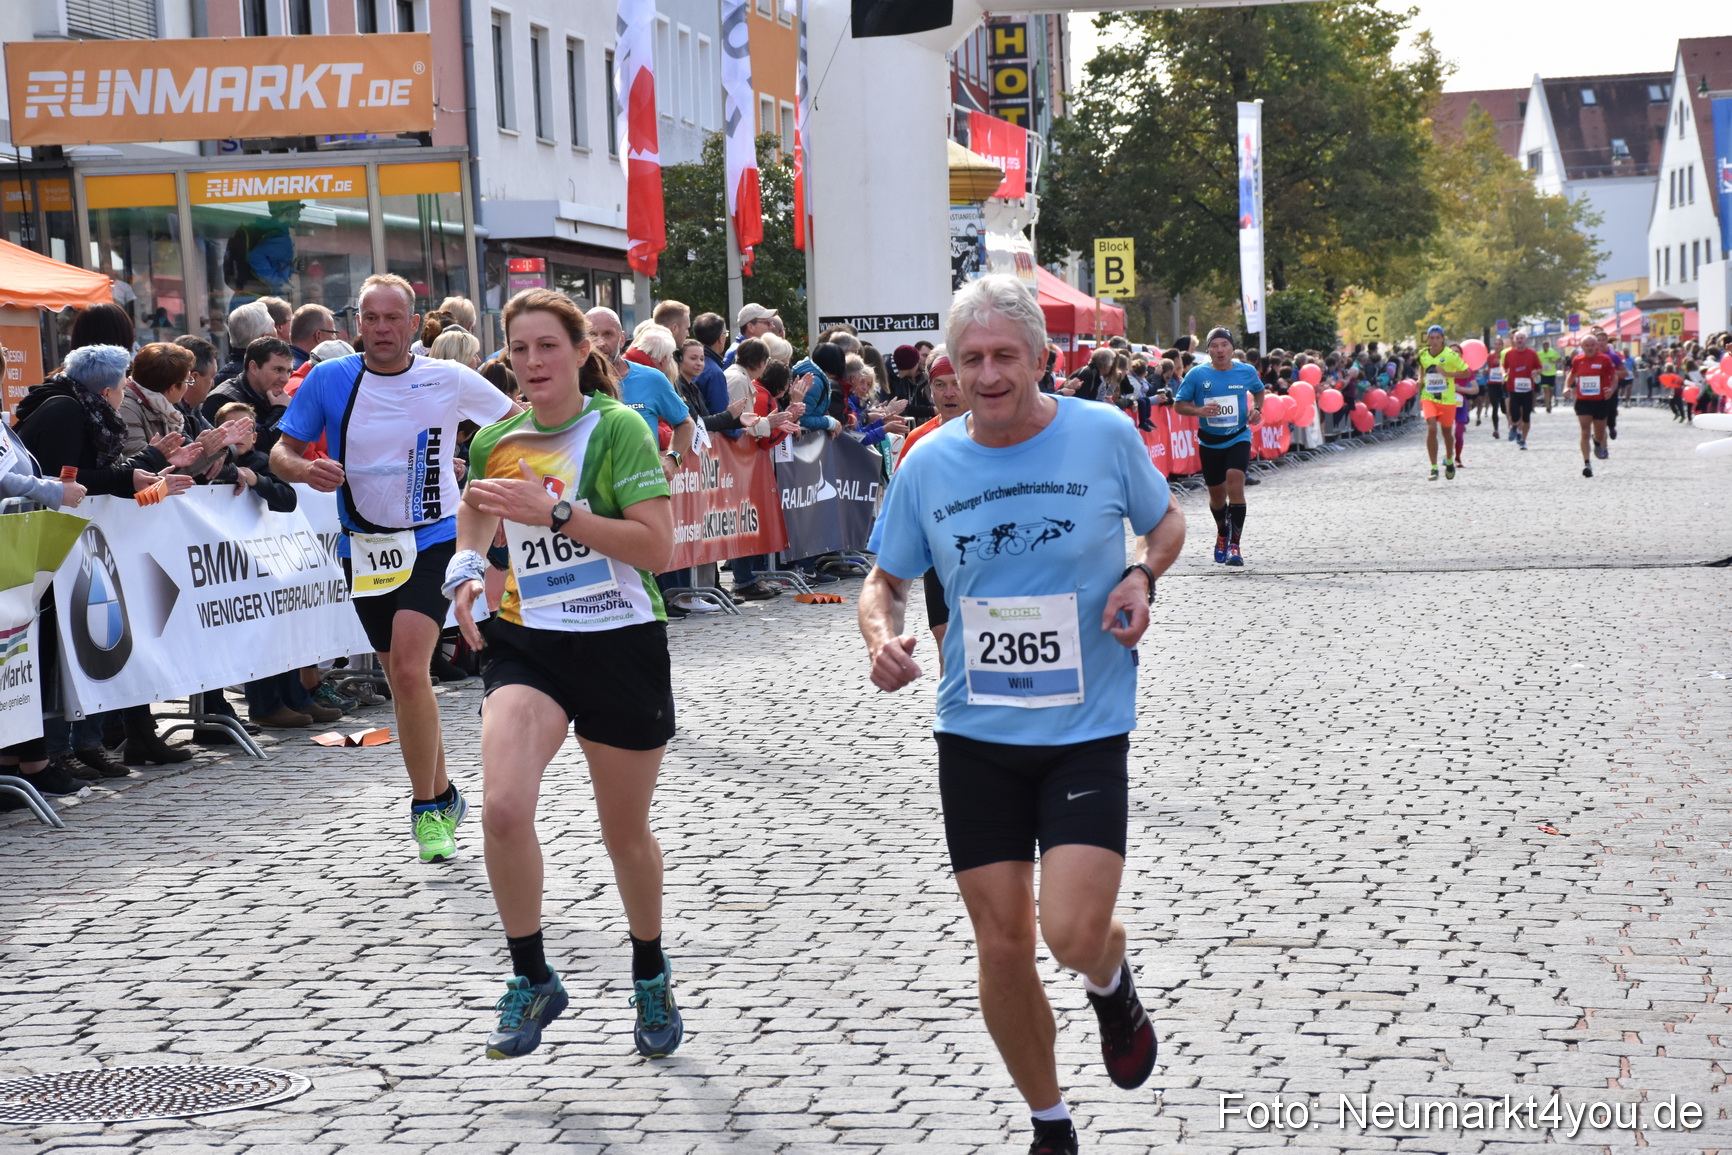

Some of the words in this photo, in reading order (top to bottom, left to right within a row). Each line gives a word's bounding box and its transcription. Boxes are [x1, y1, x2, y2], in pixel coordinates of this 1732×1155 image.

[25, 62, 413, 118] RUNMARKT.DE
[206, 174, 353, 198] RUNMARKT.DE
[1099, 241, 1130, 252] Block
[1105, 257, 1125, 284] B
[820, 314, 935, 332] wwwMINI-Partl.de
[1366, 316, 1378, 332] C
[1671, 319, 1680, 331] D
[405, 471, 413, 495] WATER
[413, 447, 425, 518] TECHNOLOGY
[422, 427, 442, 521] HUBER
[933, 509, 946, 524] 32.
[945, 495, 983, 517] Velburger
[983, 481, 1065, 503] Kirchweihtriathlon
[1066, 482, 1088, 498] 2017
[367, 549, 403, 571] 140
[522, 533, 591, 570] 2169
[373, 576, 396, 585] Werner
[546, 572, 576, 588] Sonja
[196, 593, 266, 629] WENIGER
[263, 581, 325, 617] VERBRAUCH
[562, 598, 634, 614] Lammsbräu
[569, 590, 622, 603] umarkter
[562, 612, 634, 625] www.lammsbraeu.de
[1000, 607, 1041, 618] BOCK
[978, 630, 1061, 666] 2365
[1008, 677, 1034, 689] Willi
